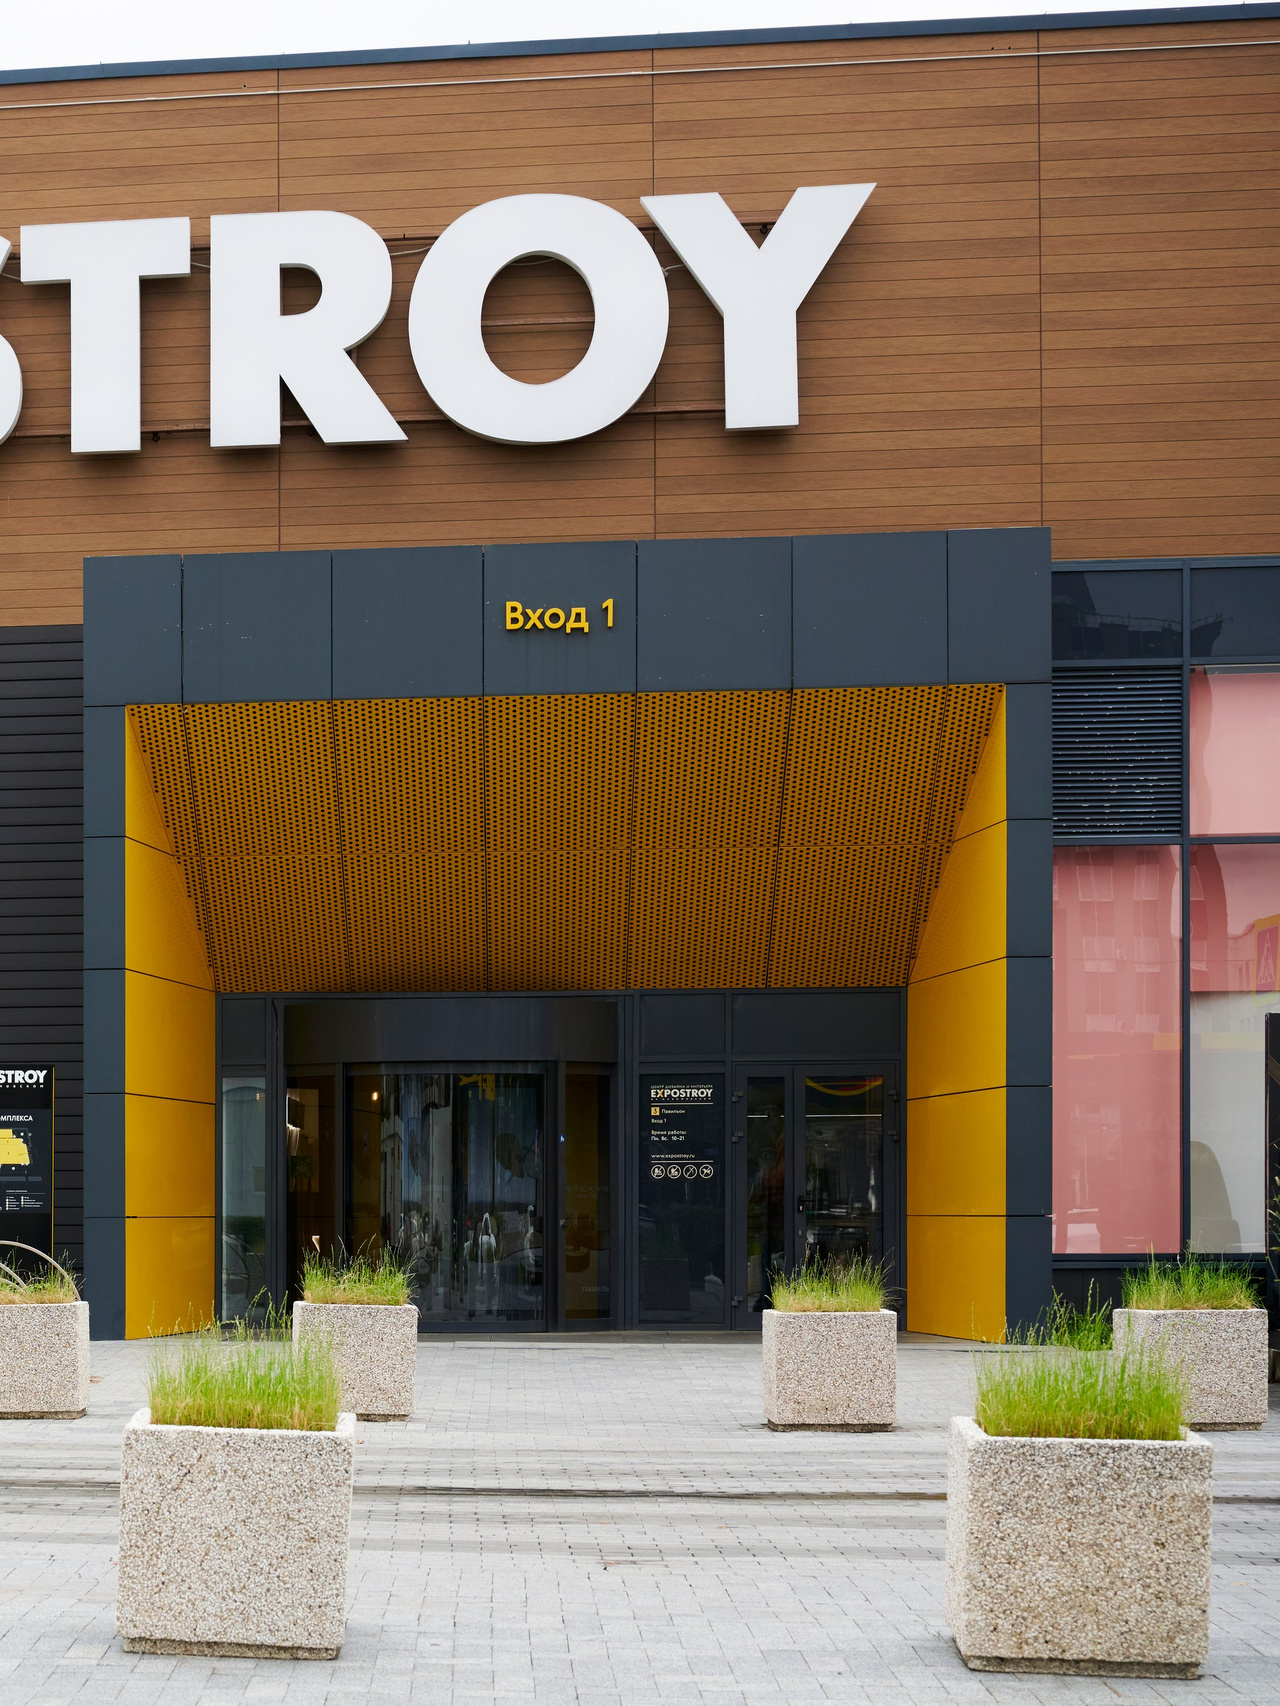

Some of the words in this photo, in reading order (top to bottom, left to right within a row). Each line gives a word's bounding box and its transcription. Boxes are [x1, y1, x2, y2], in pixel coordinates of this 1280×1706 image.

[505, 601, 589, 634] Вход
[601, 598, 614, 628] 1
[651, 1089, 713, 1098] EXPOSTROY
